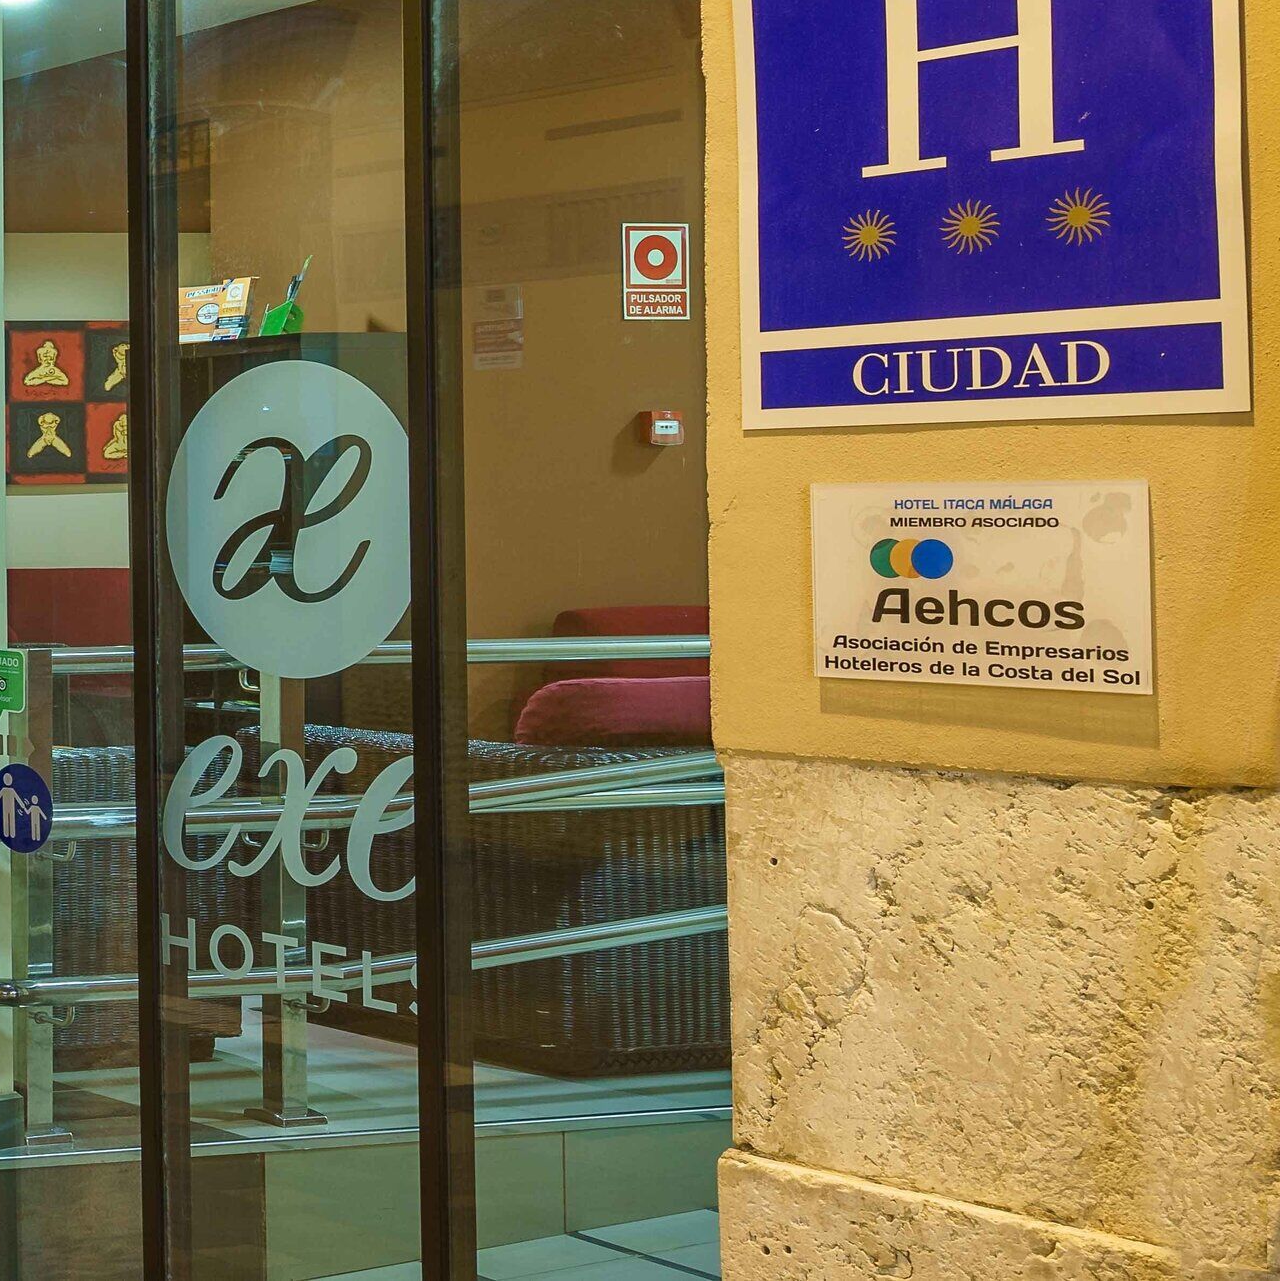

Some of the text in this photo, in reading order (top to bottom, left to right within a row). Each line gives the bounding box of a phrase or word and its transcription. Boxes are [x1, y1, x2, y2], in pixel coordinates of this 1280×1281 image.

[629, 305, 683, 314] DE ALARMA
[630, 294, 682, 303] PULSADOR
[852, 340, 1111, 397] CIUDAD
[894, 495, 1053, 510] HOTEL ITACA MÁLAGA
[890, 517, 1059, 528] MIEMBRO ASOCIADO
[871, 587, 1086, 630] Aehcos
[832, 634, 1129, 662] Asociación de Empresarios
[824, 655, 1141, 686] Hoteleros de la Costa del Sol
[162, 735, 417, 903] exe
[160, 914, 418, 1016] HOTEL
